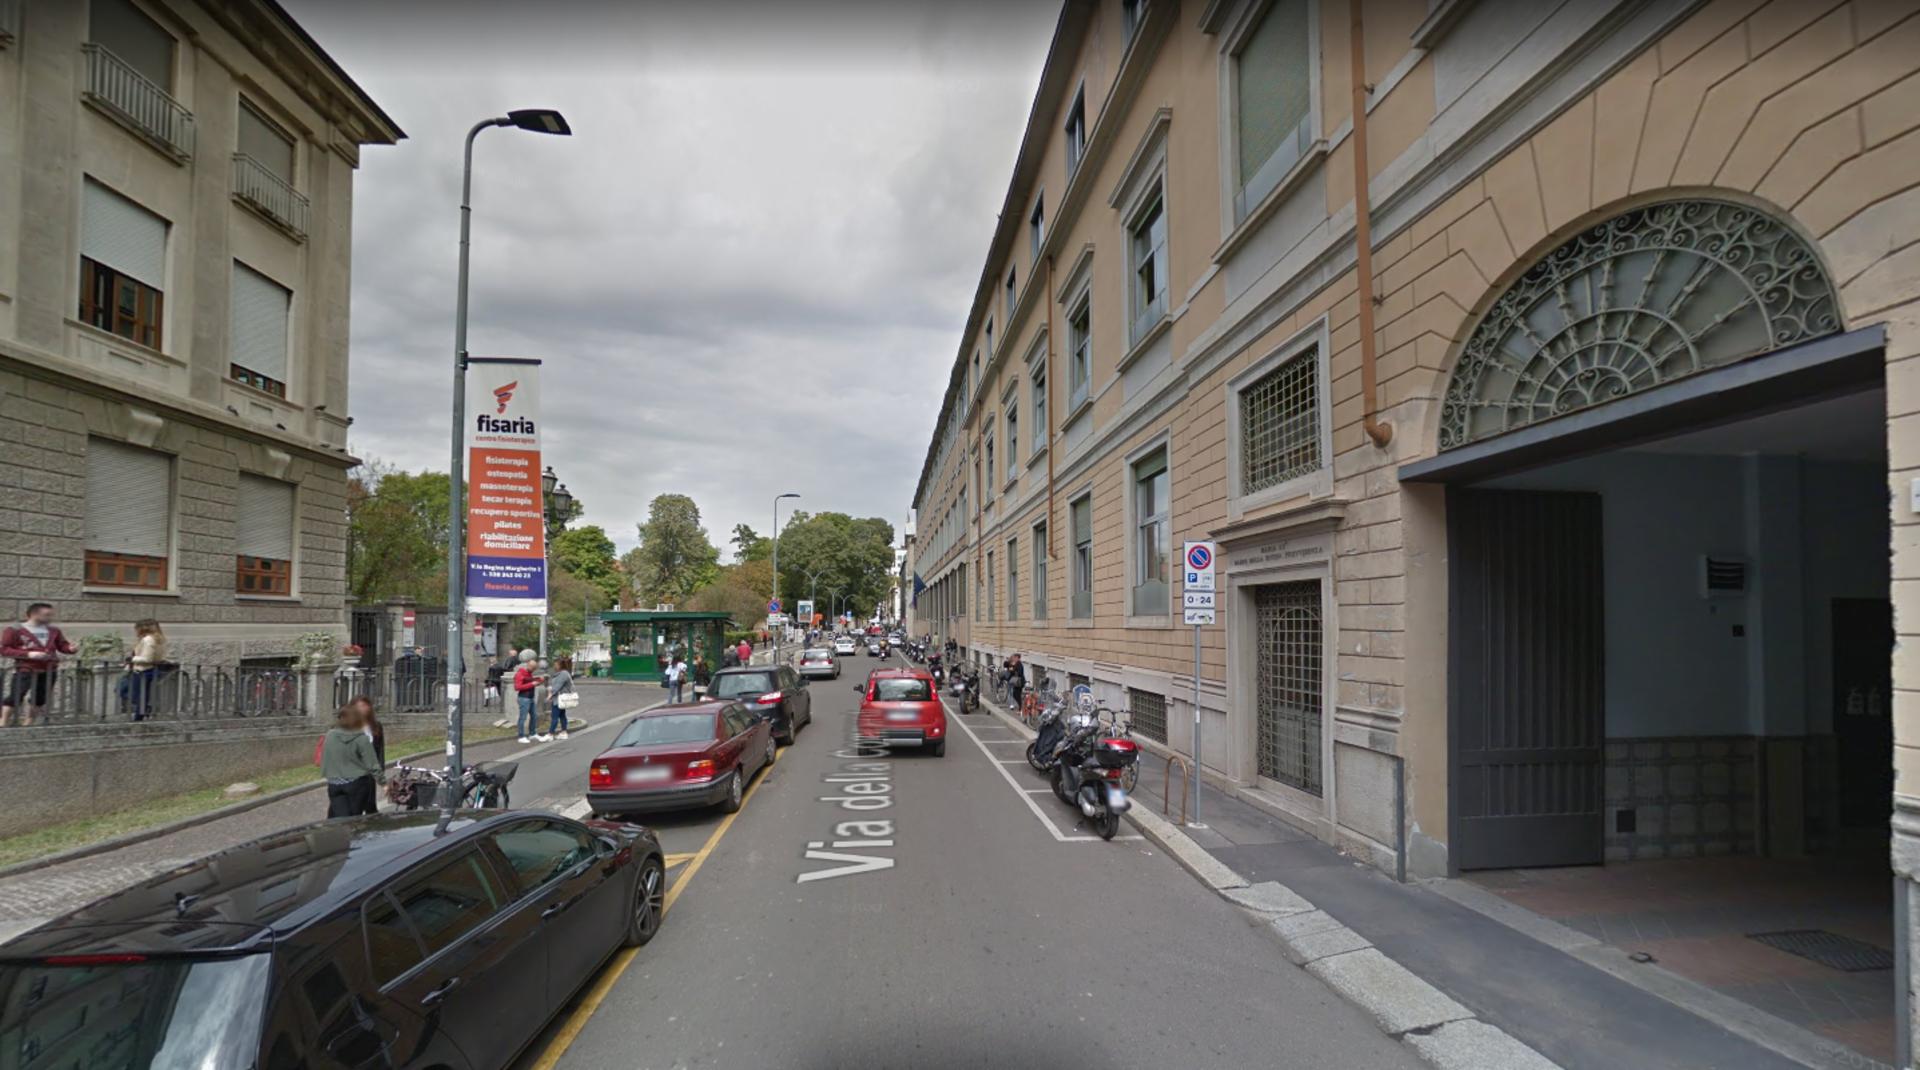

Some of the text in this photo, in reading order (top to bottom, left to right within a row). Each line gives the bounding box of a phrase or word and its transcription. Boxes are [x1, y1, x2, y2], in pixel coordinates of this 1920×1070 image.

[477, 414, 535, 434] fisaria
[485, 456, 528, 467] fisioterapia
[486, 470, 528, 479] osteopatia
[480, 482, 534, 493] massoterapia
[505, 496, 532, 505] terapia
[470, 508, 509, 517] recupero
[493, 521, 522, 529] pilates
[480, 532, 534, 542] riabilitazione
[483, 541, 531, 550] domiciliare
[1200, 596, 1212, 604] 24
